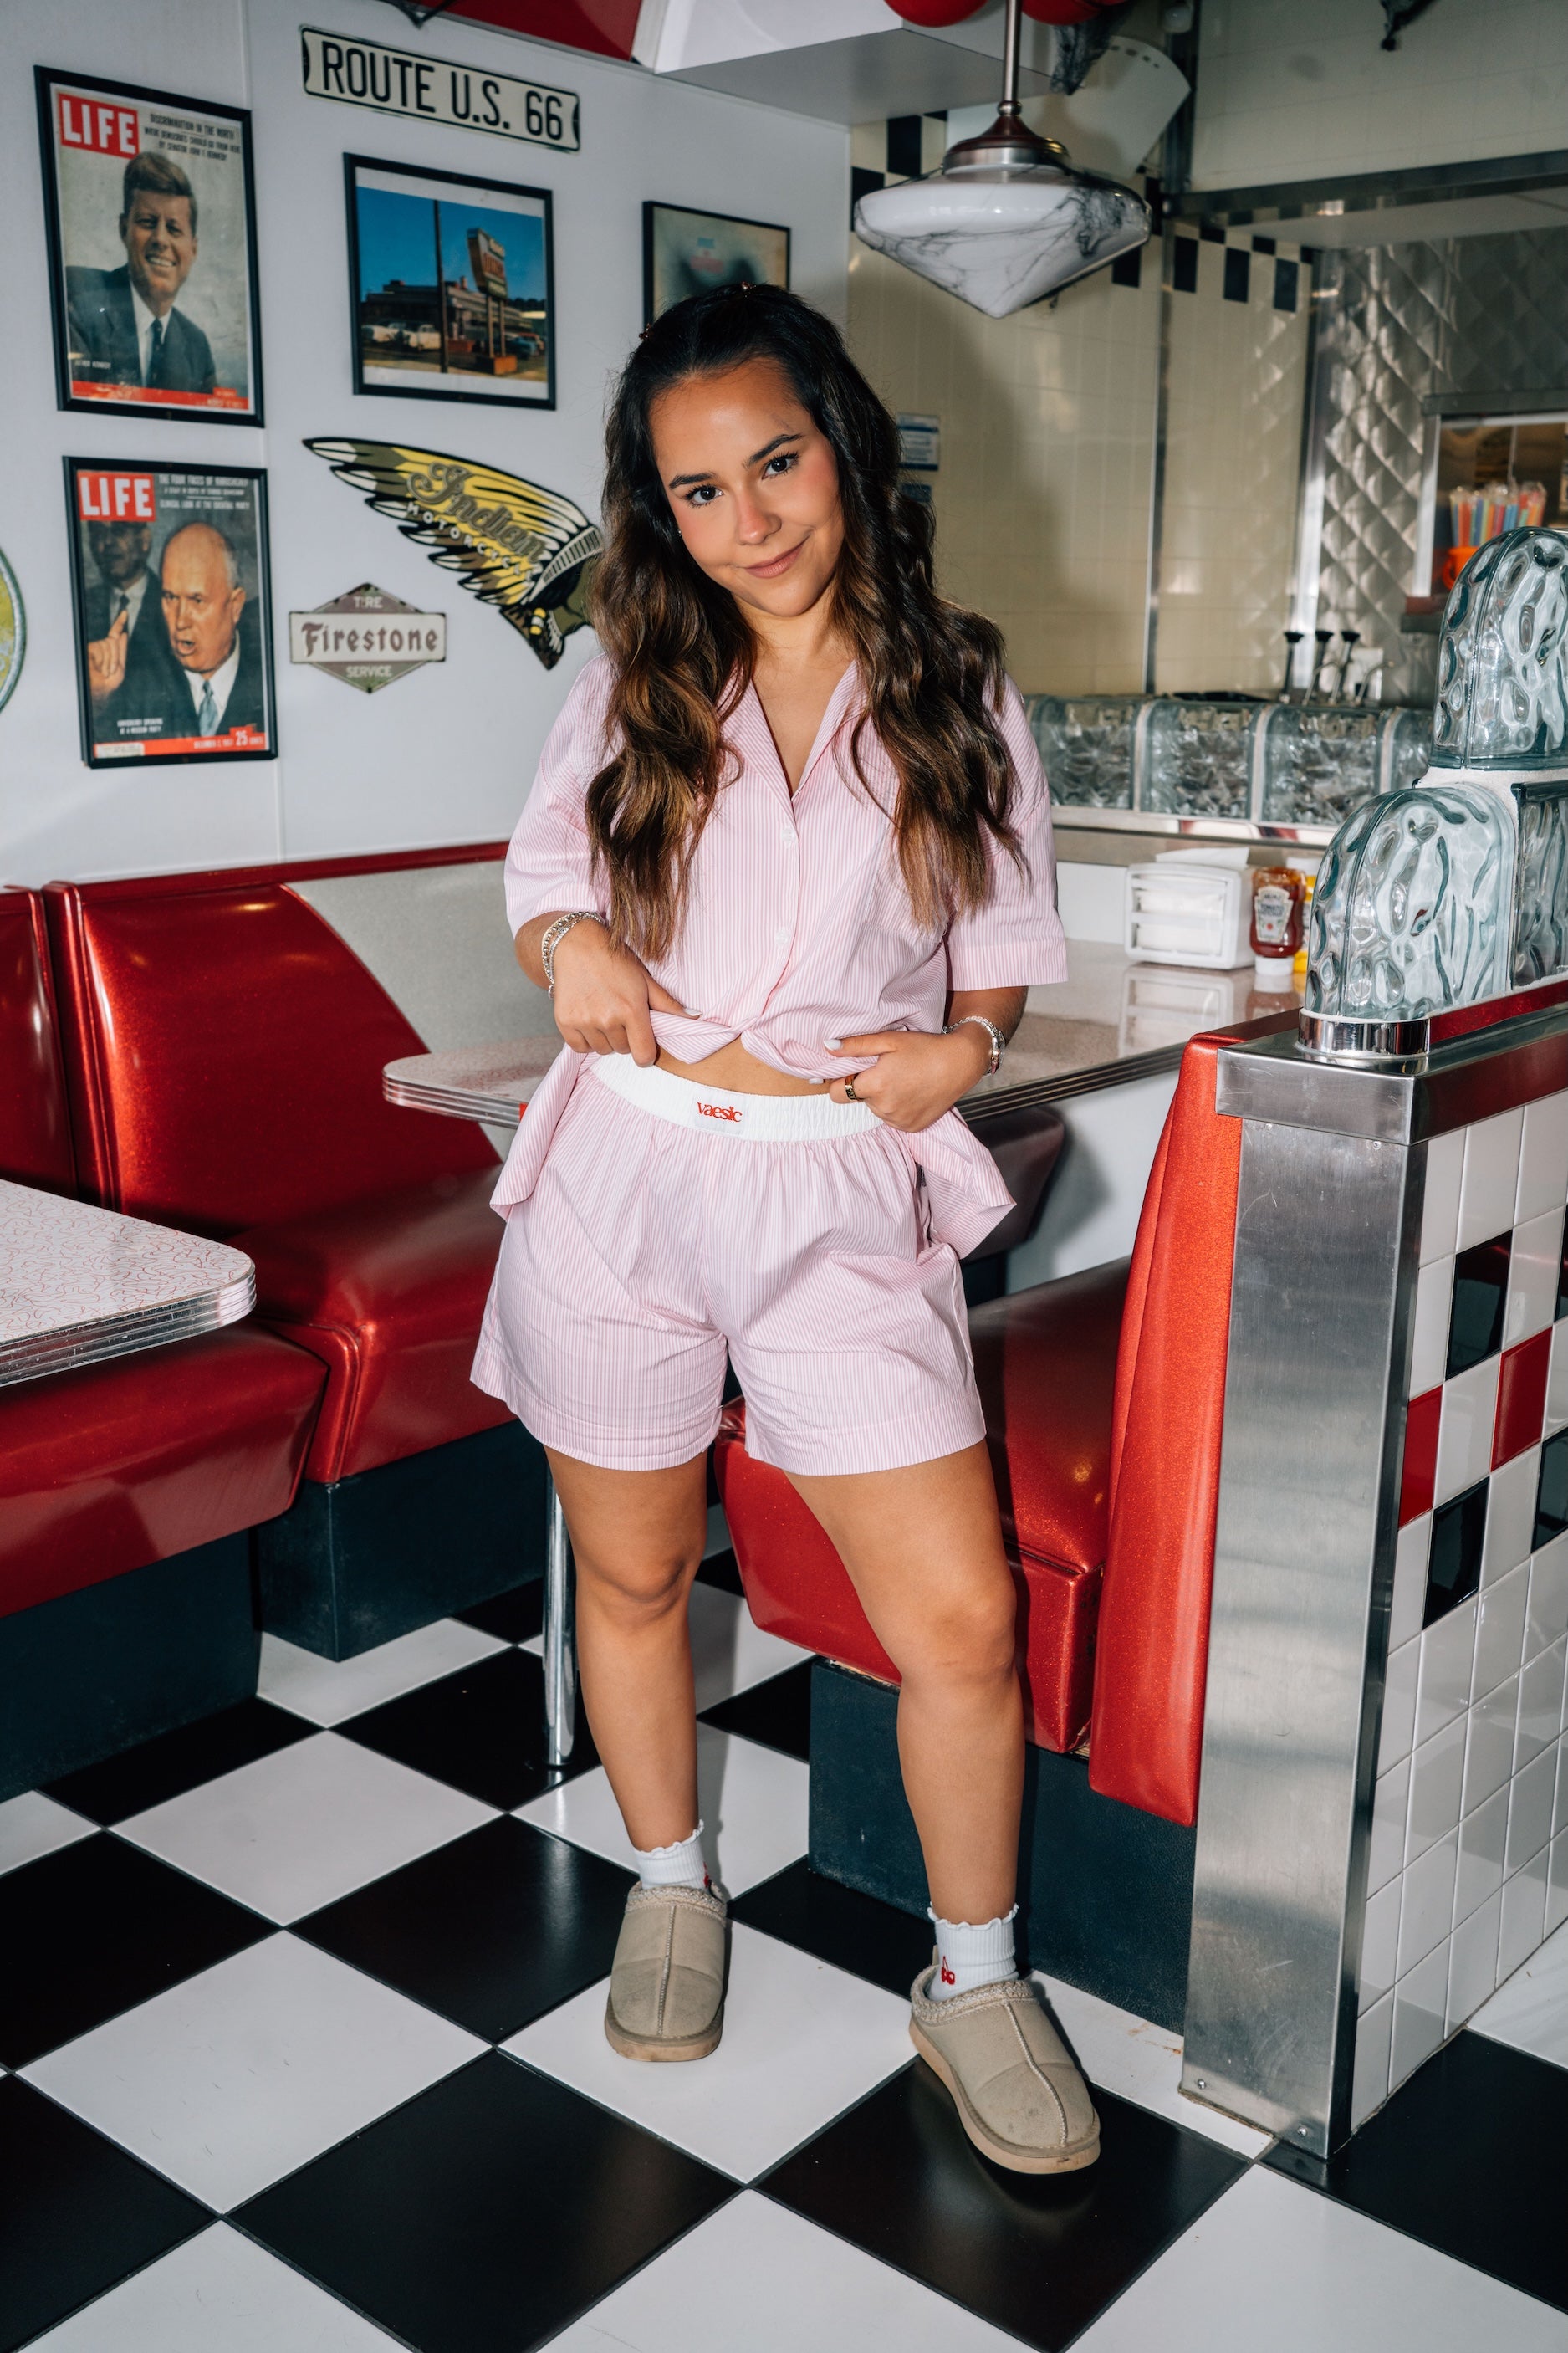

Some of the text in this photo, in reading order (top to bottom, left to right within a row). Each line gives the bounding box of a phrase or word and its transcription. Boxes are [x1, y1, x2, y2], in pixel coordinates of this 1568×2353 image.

[321, 40, 562, 141] ROUTE U.S. 66
[62, 99, 136, 154] LIFE
[79, 477, 153, 517] LIFE
[406, 462, 547, 564] Indian
[406, 501, 533, 583] MOTORCYCLE
[301, 622, 437, 657] Firestone
[345, 665, 392, 678] SERVICE
[235, 729, 248, 746] 25
[697, 1101, 743, 1123] vaesic
